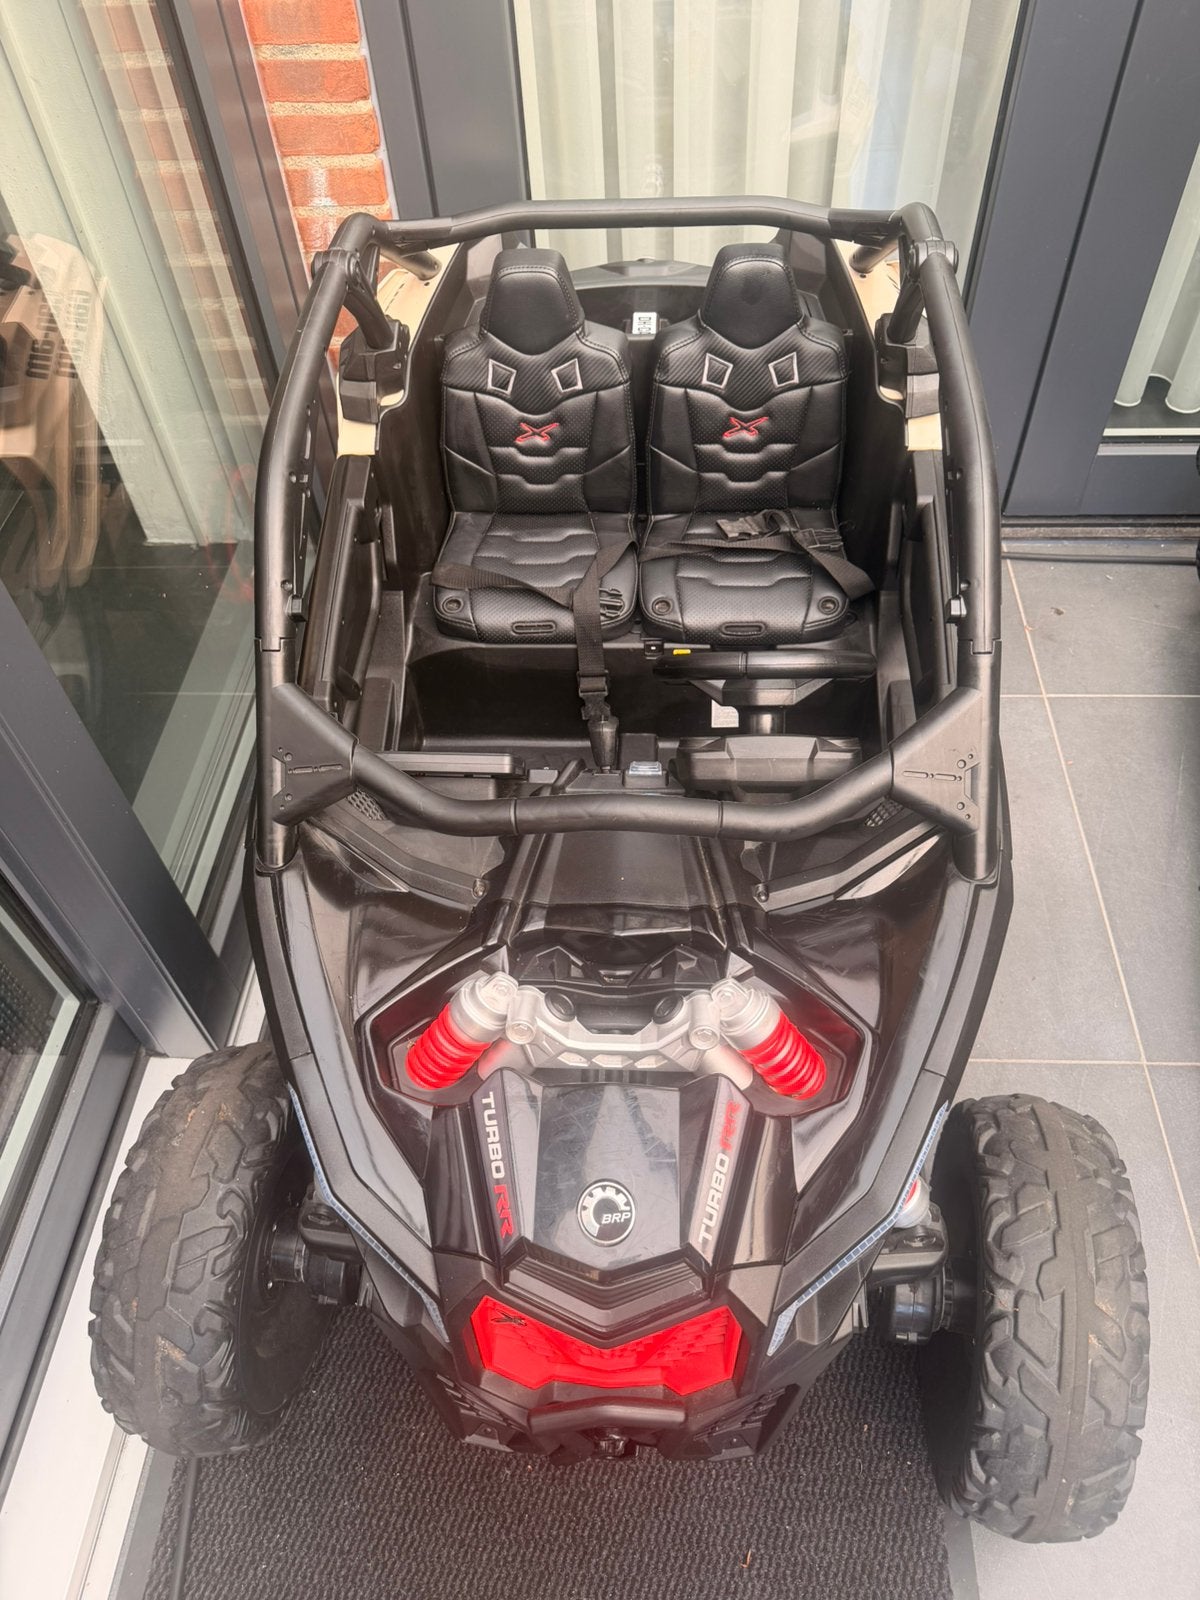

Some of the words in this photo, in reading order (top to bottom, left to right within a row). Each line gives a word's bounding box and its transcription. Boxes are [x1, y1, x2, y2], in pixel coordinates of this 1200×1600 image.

[481, 1091, 506, 1180] TURBO
[698, 1152, 731, 1244] TURBO
[719, 1099, 741, 1152] RR
[493, 1183, 515, 1240] RR
[601, 1212, 631, 1225] BRP
